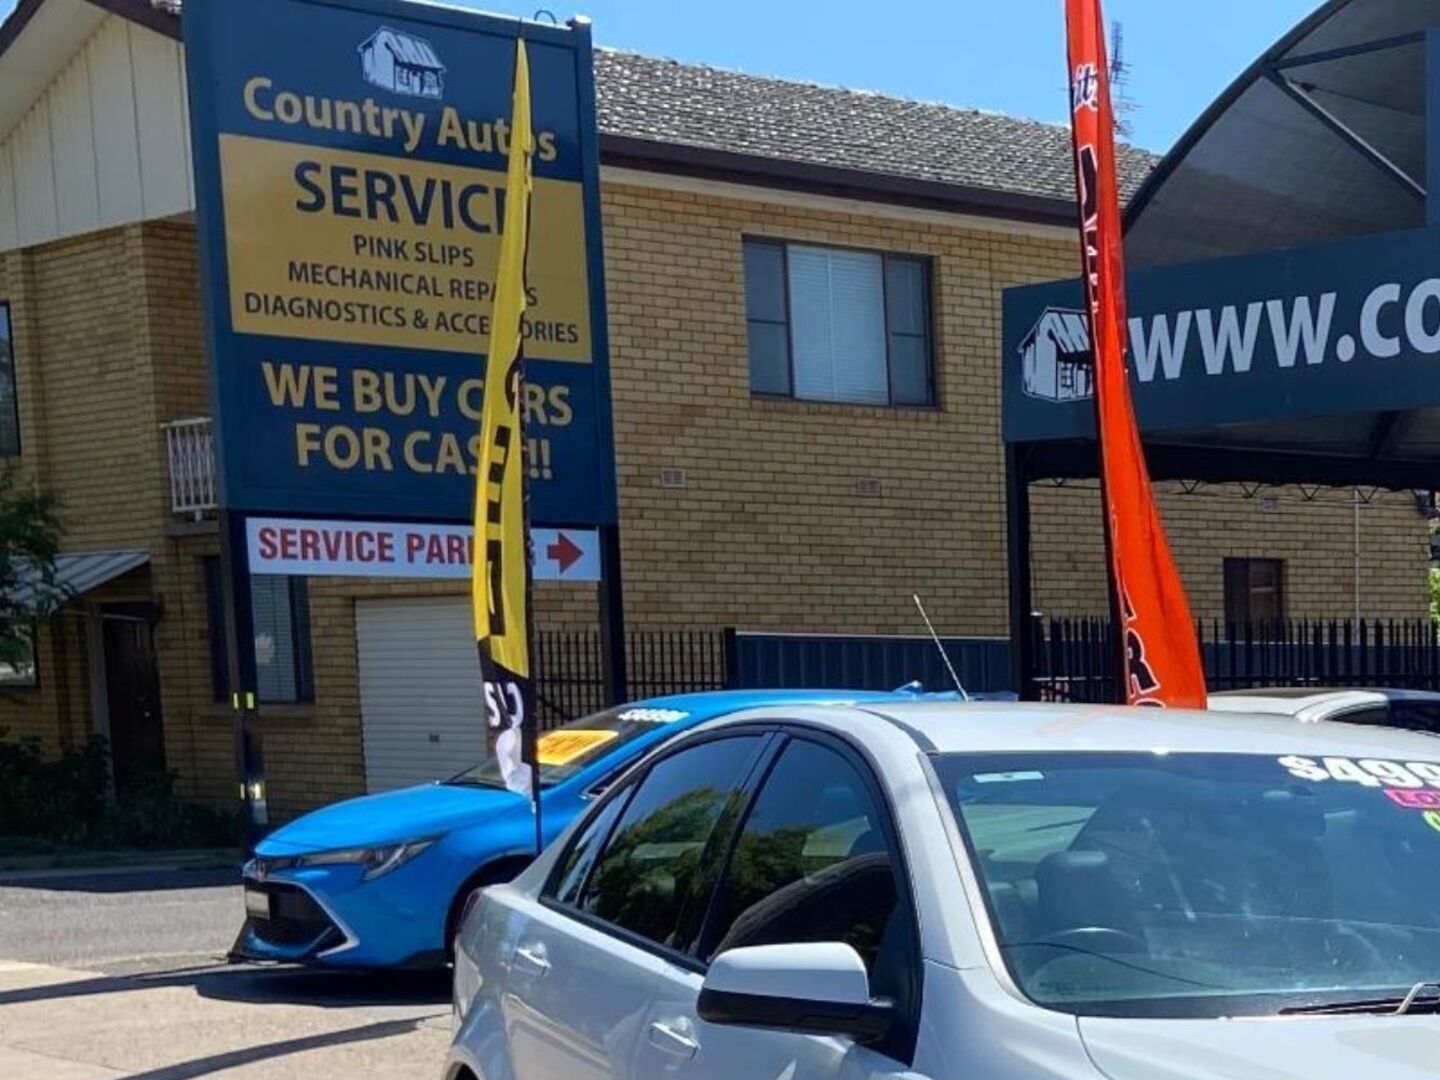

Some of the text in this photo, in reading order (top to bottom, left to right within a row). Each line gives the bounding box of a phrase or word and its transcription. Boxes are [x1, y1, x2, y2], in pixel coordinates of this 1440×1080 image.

[243, 76, 425, 153] Country
[353, 234, 475, 268] PINK SLIPS
[288, 260, 444, 298] MECHANICAL
[244, 291, 407, 328] DIAGNOSTICS
[412, 308, 429, 330] &
[261, 360, 574, 427] WE BUY CRS
[294, 422, 395, 472] FOR
[258, 526, 396, 564] SERVICE
